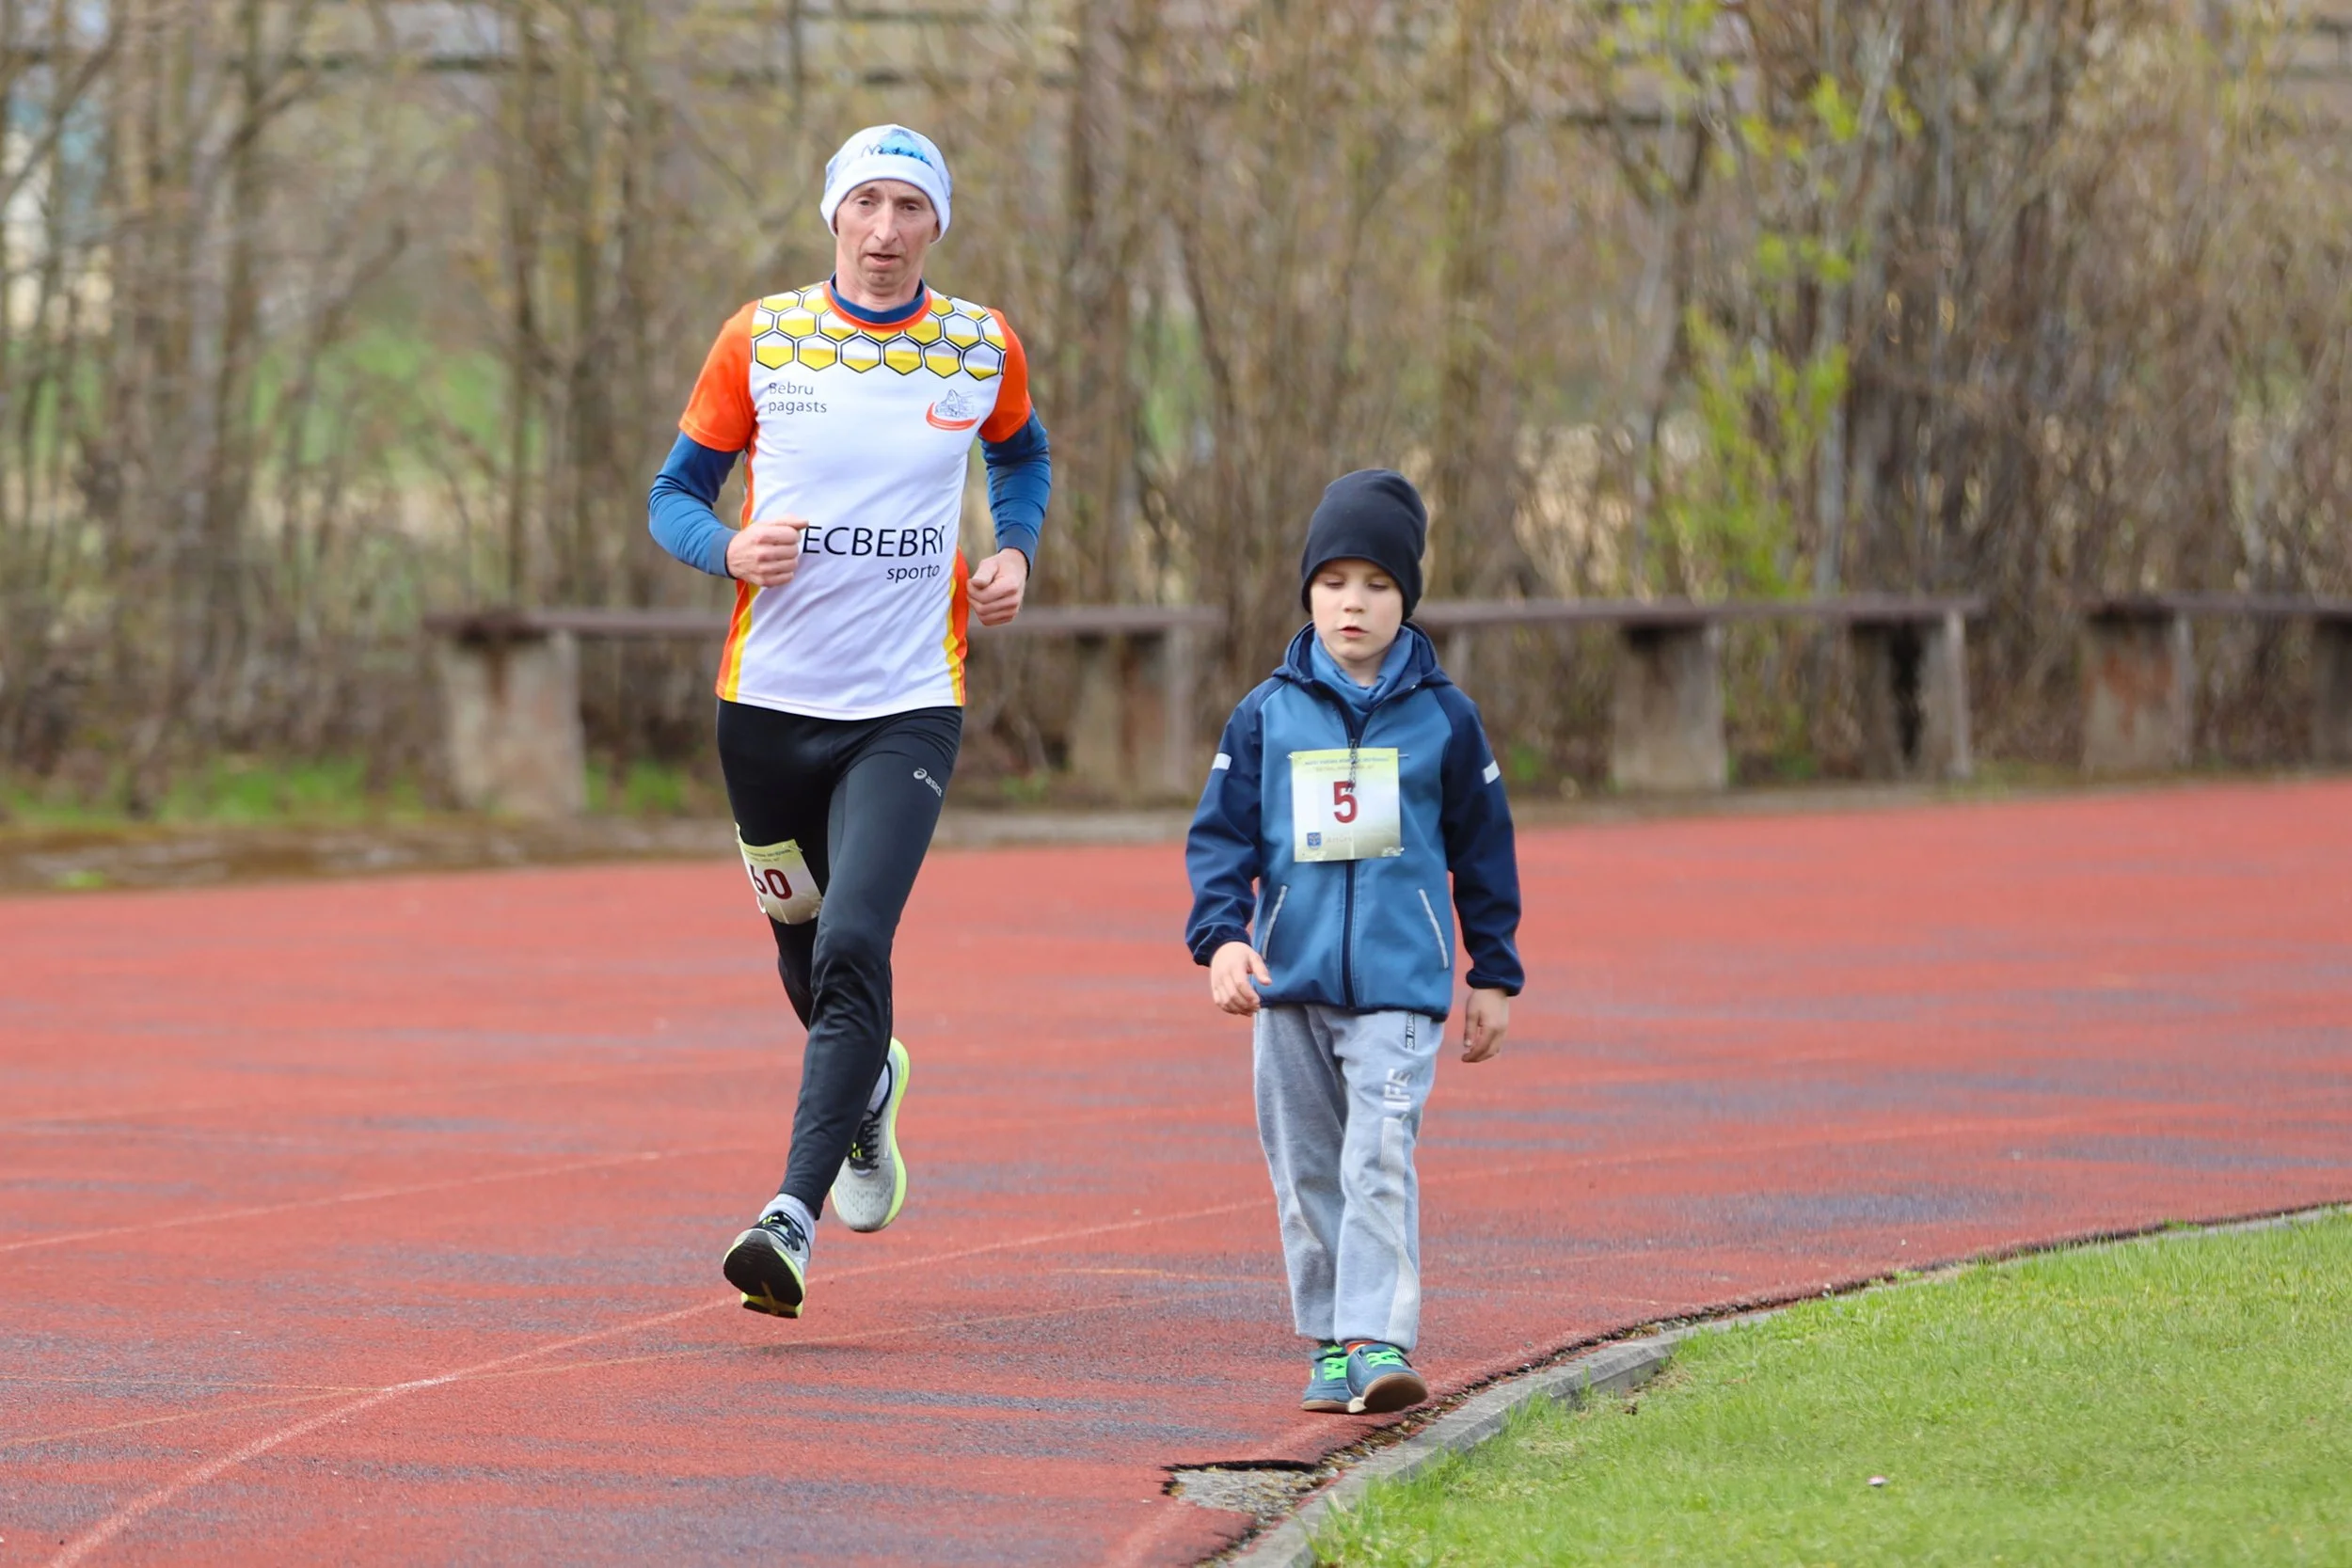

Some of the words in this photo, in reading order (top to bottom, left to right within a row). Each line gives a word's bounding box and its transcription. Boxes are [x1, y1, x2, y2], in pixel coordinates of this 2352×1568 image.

[769, 381, 814, 396] Bebru
[768, 401, 828, 415] pagasts
[886, 564, 940, 583] sporto
[1333, 780, 1358, 824] 5
[750, 863, 793, 900] 60
